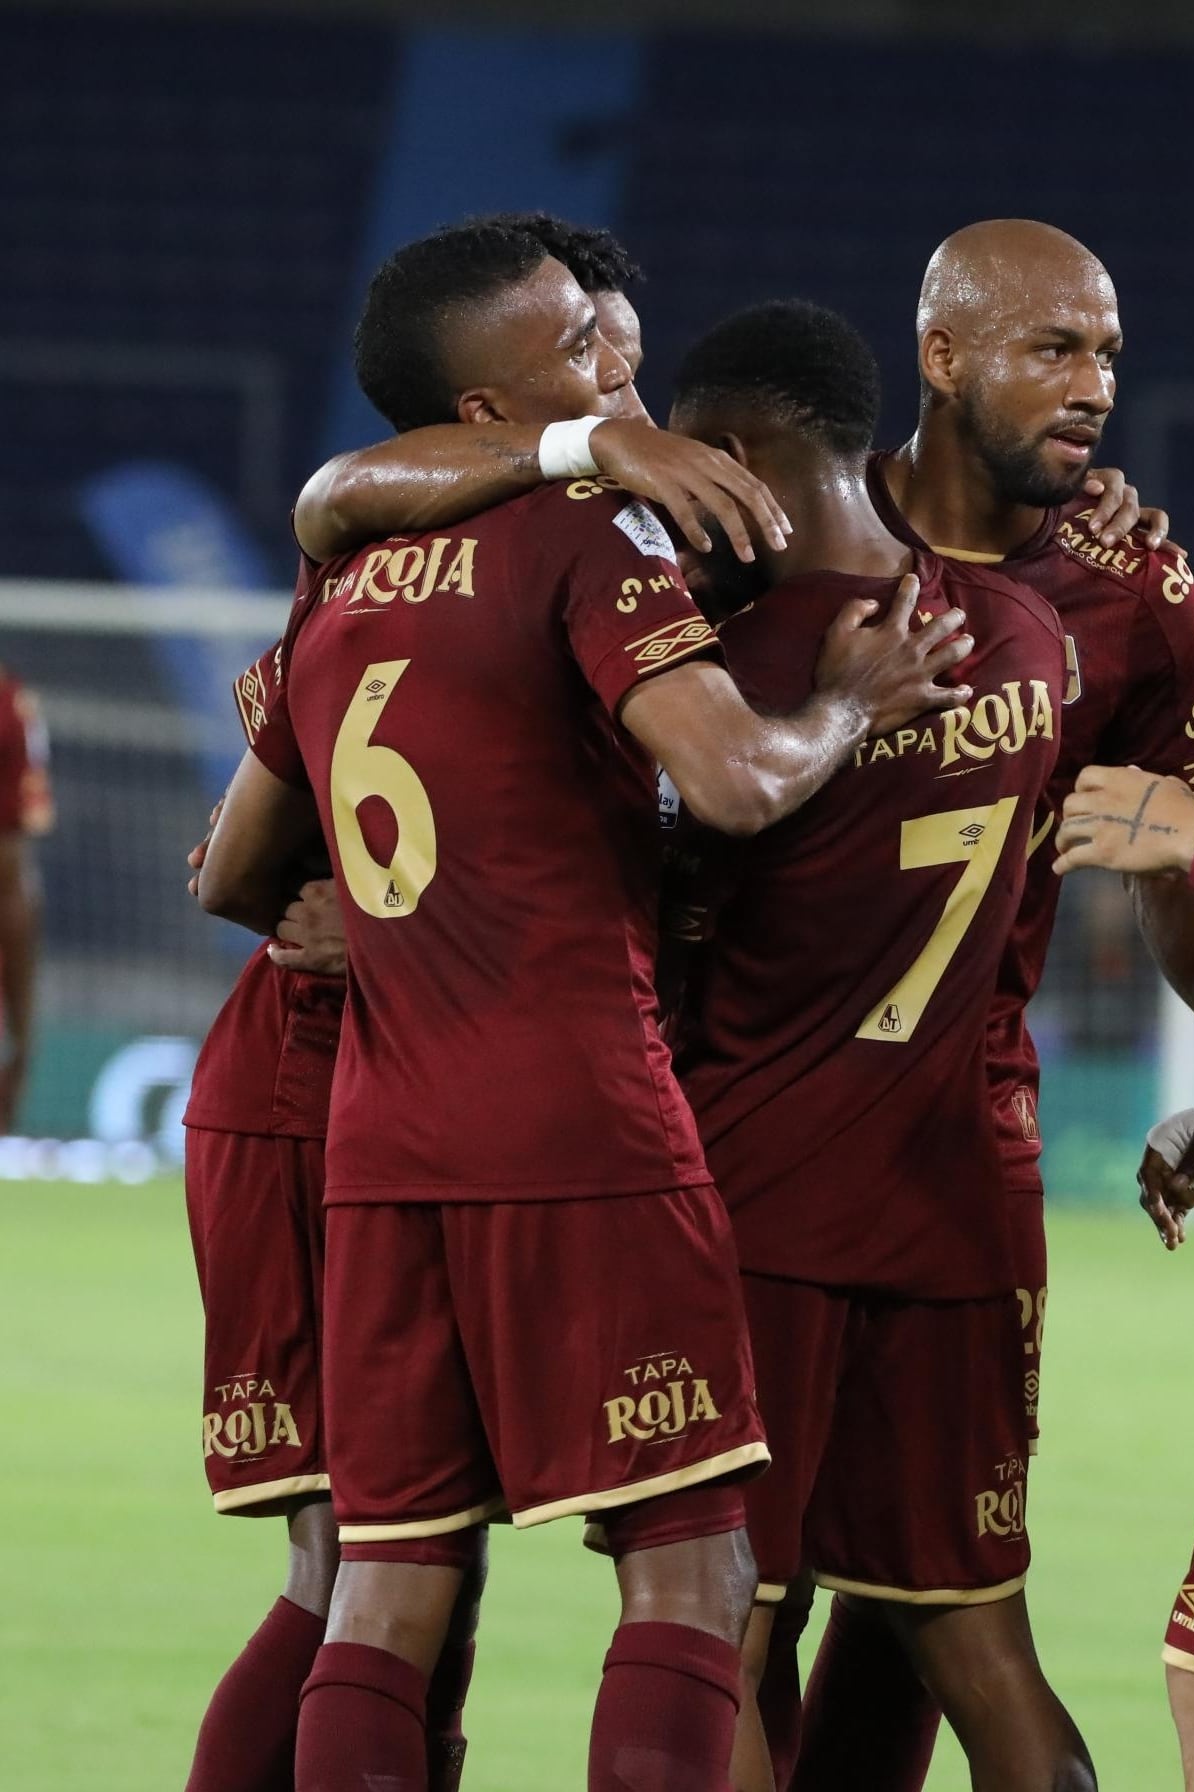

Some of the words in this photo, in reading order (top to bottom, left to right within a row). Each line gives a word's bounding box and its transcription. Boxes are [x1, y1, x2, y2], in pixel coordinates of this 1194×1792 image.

[345, 537, 479, 606] ROJA
[1057, 521, 1142, 575] Multi
[854, 727, 937, 768] TAPA
[939, 679, 1054, 769] ROJA
[330, 658, 437, 919] 6
[854, 795, 1020, 1044] 7
[214, 1379, 277, 1402] TAPA
[623, 1357, 694, 1386] TAPA
[203, 1402, 302, 1459] ROJA
[602, 1379, 723, 1445] ROJA
